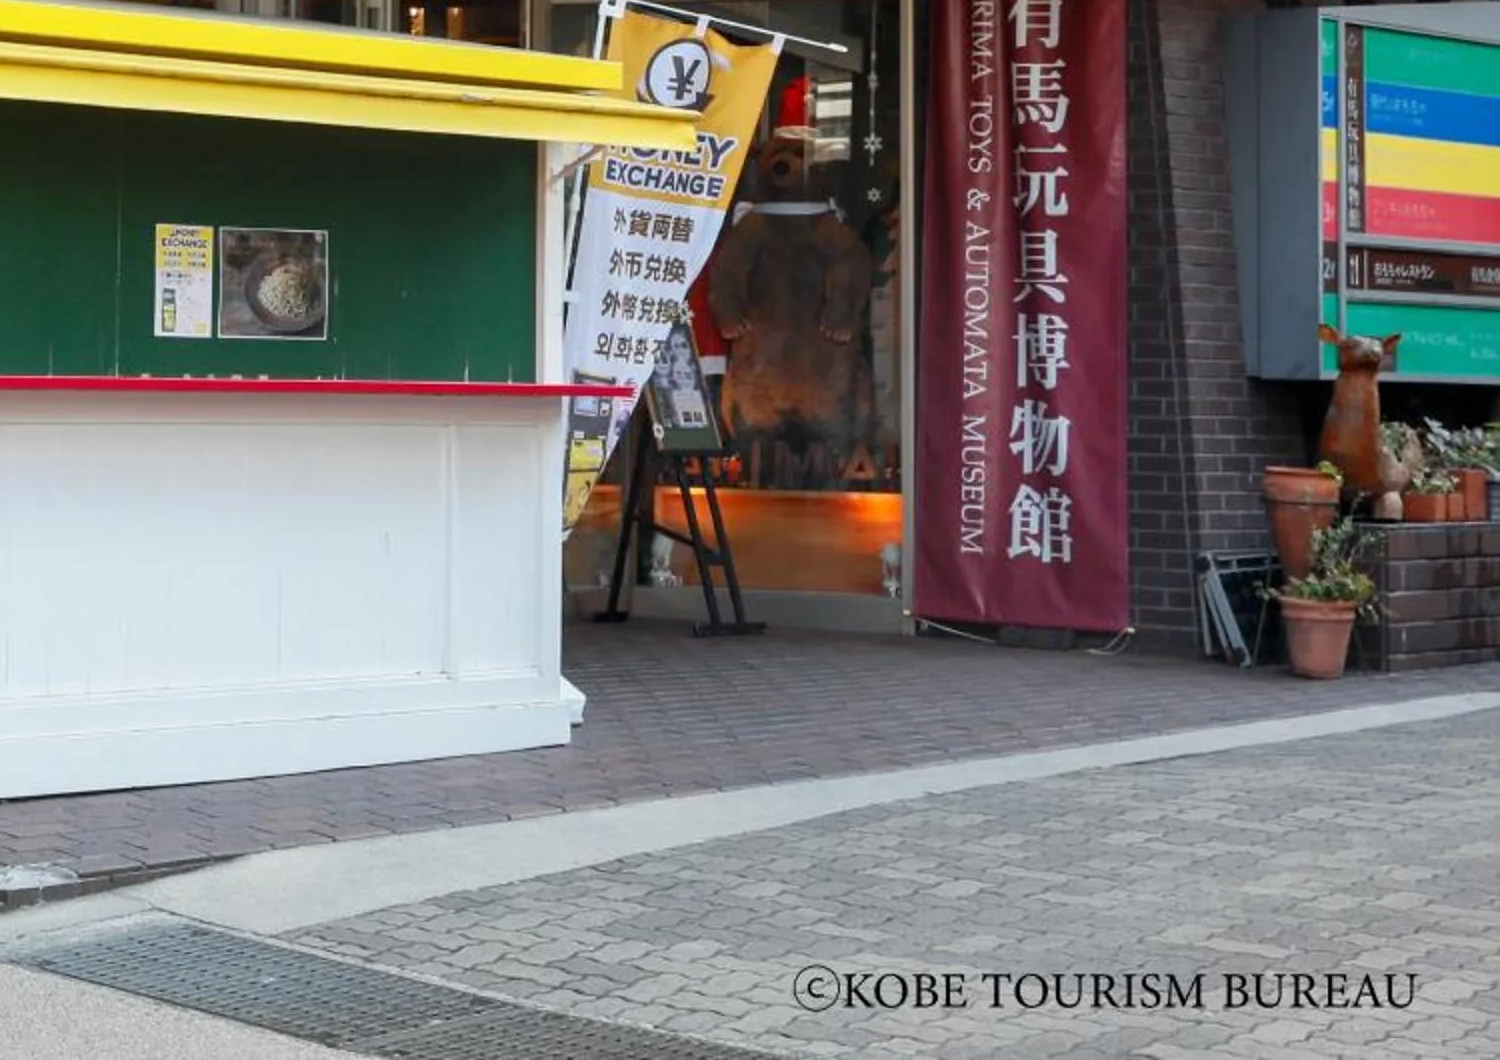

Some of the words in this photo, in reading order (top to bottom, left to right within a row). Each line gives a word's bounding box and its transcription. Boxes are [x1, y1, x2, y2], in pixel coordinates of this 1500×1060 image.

[967, 94, 994, 174] TOYS
[604, 157, 725, 199] EXCHANGE
[966, 187, 992, 212] &
[613, 205, 695, 244] 外貨両替
[962, 219, 991, 400] AUTOMATA
[960, 414, 988, 555] MUSEUM
